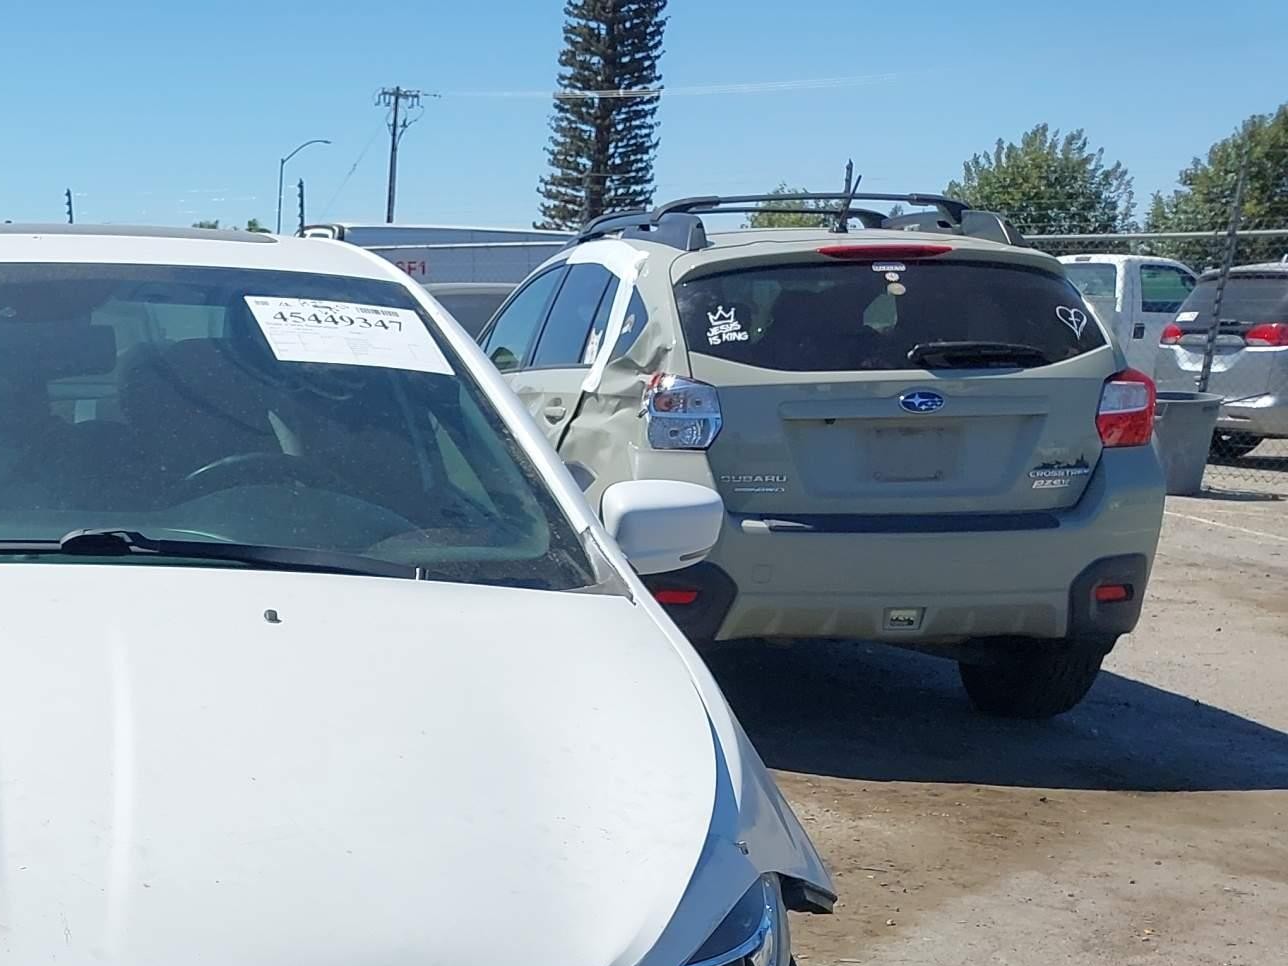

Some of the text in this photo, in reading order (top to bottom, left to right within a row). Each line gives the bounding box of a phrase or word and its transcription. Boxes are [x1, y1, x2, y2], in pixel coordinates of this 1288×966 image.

[272, 311, 402, 332] 45449347
[707, 321, 741, 337] JESUS
[708, 331, 749, 346] IS KING
